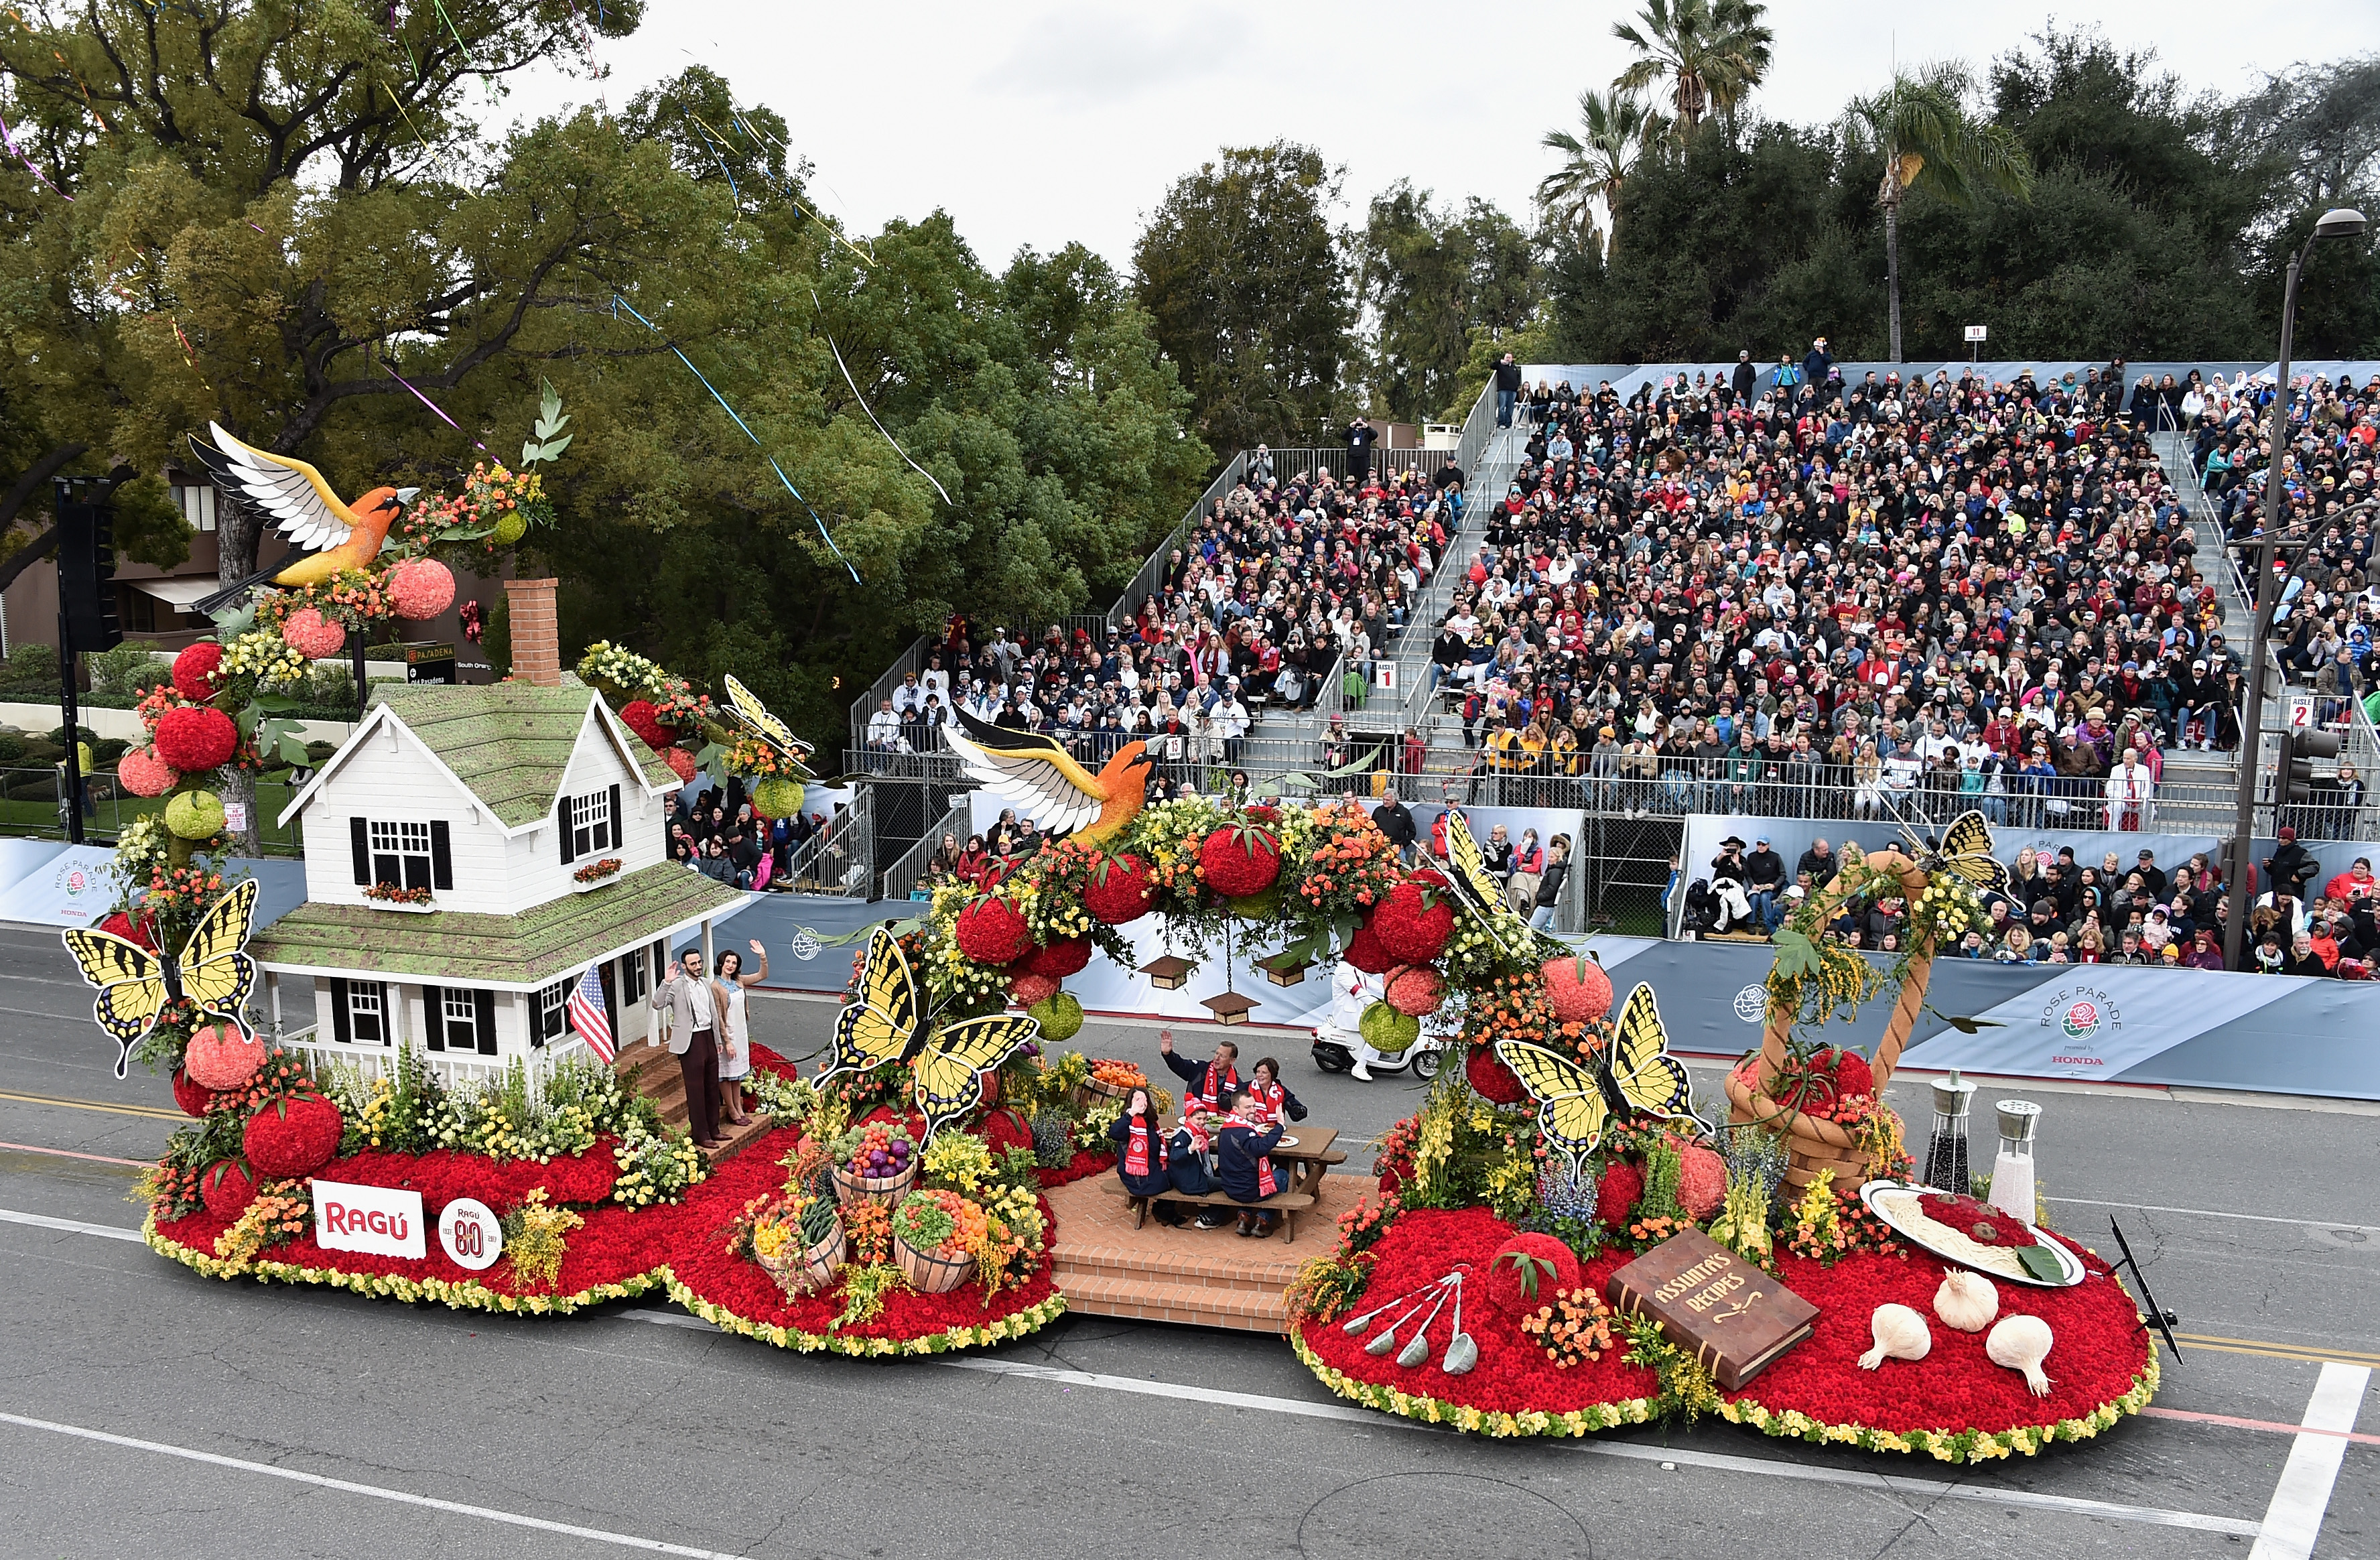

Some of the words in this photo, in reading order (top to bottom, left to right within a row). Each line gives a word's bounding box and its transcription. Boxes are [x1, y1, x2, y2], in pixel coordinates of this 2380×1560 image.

[1972, 328, 1980, 336] 11
[417, 647, 454, 659] PASADENA
[421, 676, 444, 684] Pasadena
[1382, 671, 1390, 686] 1
[2292, 698, 2312, 706] AISLE
[2294, 706, 2307, 726] 2
[1171, 739, 1179, 753] 15
[54, 862, 70, 889] ROSE
[72, 860, 98, 893] PARADE
[60, 909, 87, 917] HONDA
[2040, 990, 2070, 1027] ROSE
[2076, 986, 2122, 1031] PARADE
[2052, 1055, 2104, 1065] HONDA
[454, 1220, 484, 1258] 80
[1654, 1252, 1731, 1304] ASSUNTA'S
[1685, 1272, 1745, 1313] RECIPES
